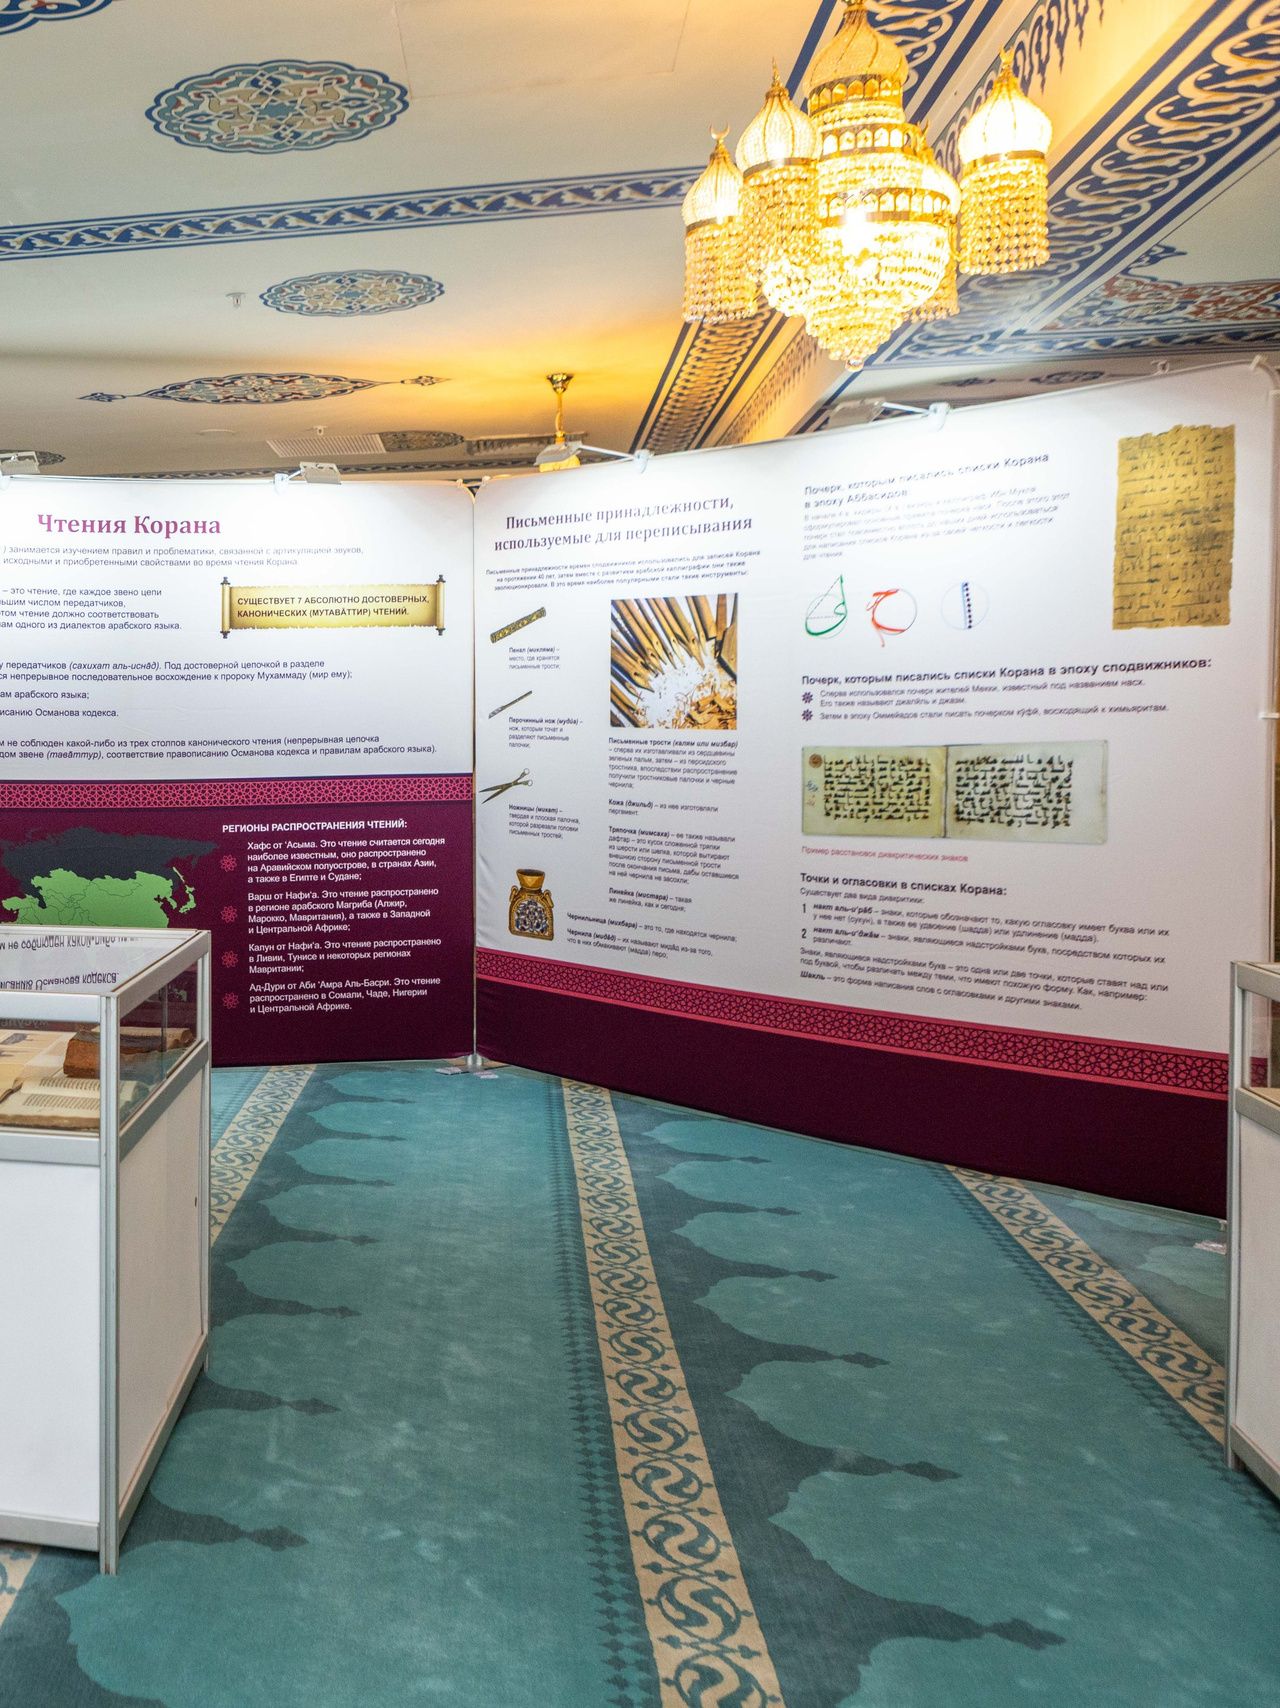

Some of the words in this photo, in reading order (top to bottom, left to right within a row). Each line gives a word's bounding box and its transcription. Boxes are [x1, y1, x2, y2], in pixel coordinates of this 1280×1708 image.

[506, 511, 593, 530] Письменные
[596, 497, 734, 524] принадлежности,
[38, 514, 126, 534] Чтения
[134, 515, 221, 539] Корана
[494, 533, 592, 552] используемые
[594, 531, 622, 545] для
[625, 518, 753, 543] переписывания
[237, 597, 295, 606] СУЩЕСТВУЕТ
[304, 596, 360, 604] АБСОЛЮТНО
[361, 595, 430, 604] ДОСТОВЕРНЫХ,
[801, 675, 842, 687] Почерк,
[844, 675, 893, 685] которым
[895, 672, 951, 682] писались
[953, 670, 996, 680] списки
[999, 667, 1045, 680] Корана
[1048, 667, 1057, 676] в
[1060, 665, 1099, 677] эпоху
[1102, 659, 1212, 673] сподвижников:
[14, 690, 59, 700] арабского
[60, 692, 90, 700] языка;
[222, 823, 269, 833] РЕГИОНЫ
[271, 821, 365, 831] РАСПРОСТРАНЕНИЯ
[367, 818, 407, 829] ЧТЕНИЙ:
[247, 852, 289, 861] наиболее
[290, 852, 339, 860] известным,
[340, 851, 357, 859] оно
[358, 849, 427, 860] распространено
[255, 875, 281, 883] также
[289, 873, 319, 882] Египте
[327, 872, 362, 882] Судане;
[800, 872, 830, 884] Точки
[841, 878, 897, 889] огласовки
[910, 882, 956, 892] списках
[960, 883, 1007, 896] Корана:
[257, 1003, 315, 1014] Центральной
[316, 1002, 352, 1012] Африке.
